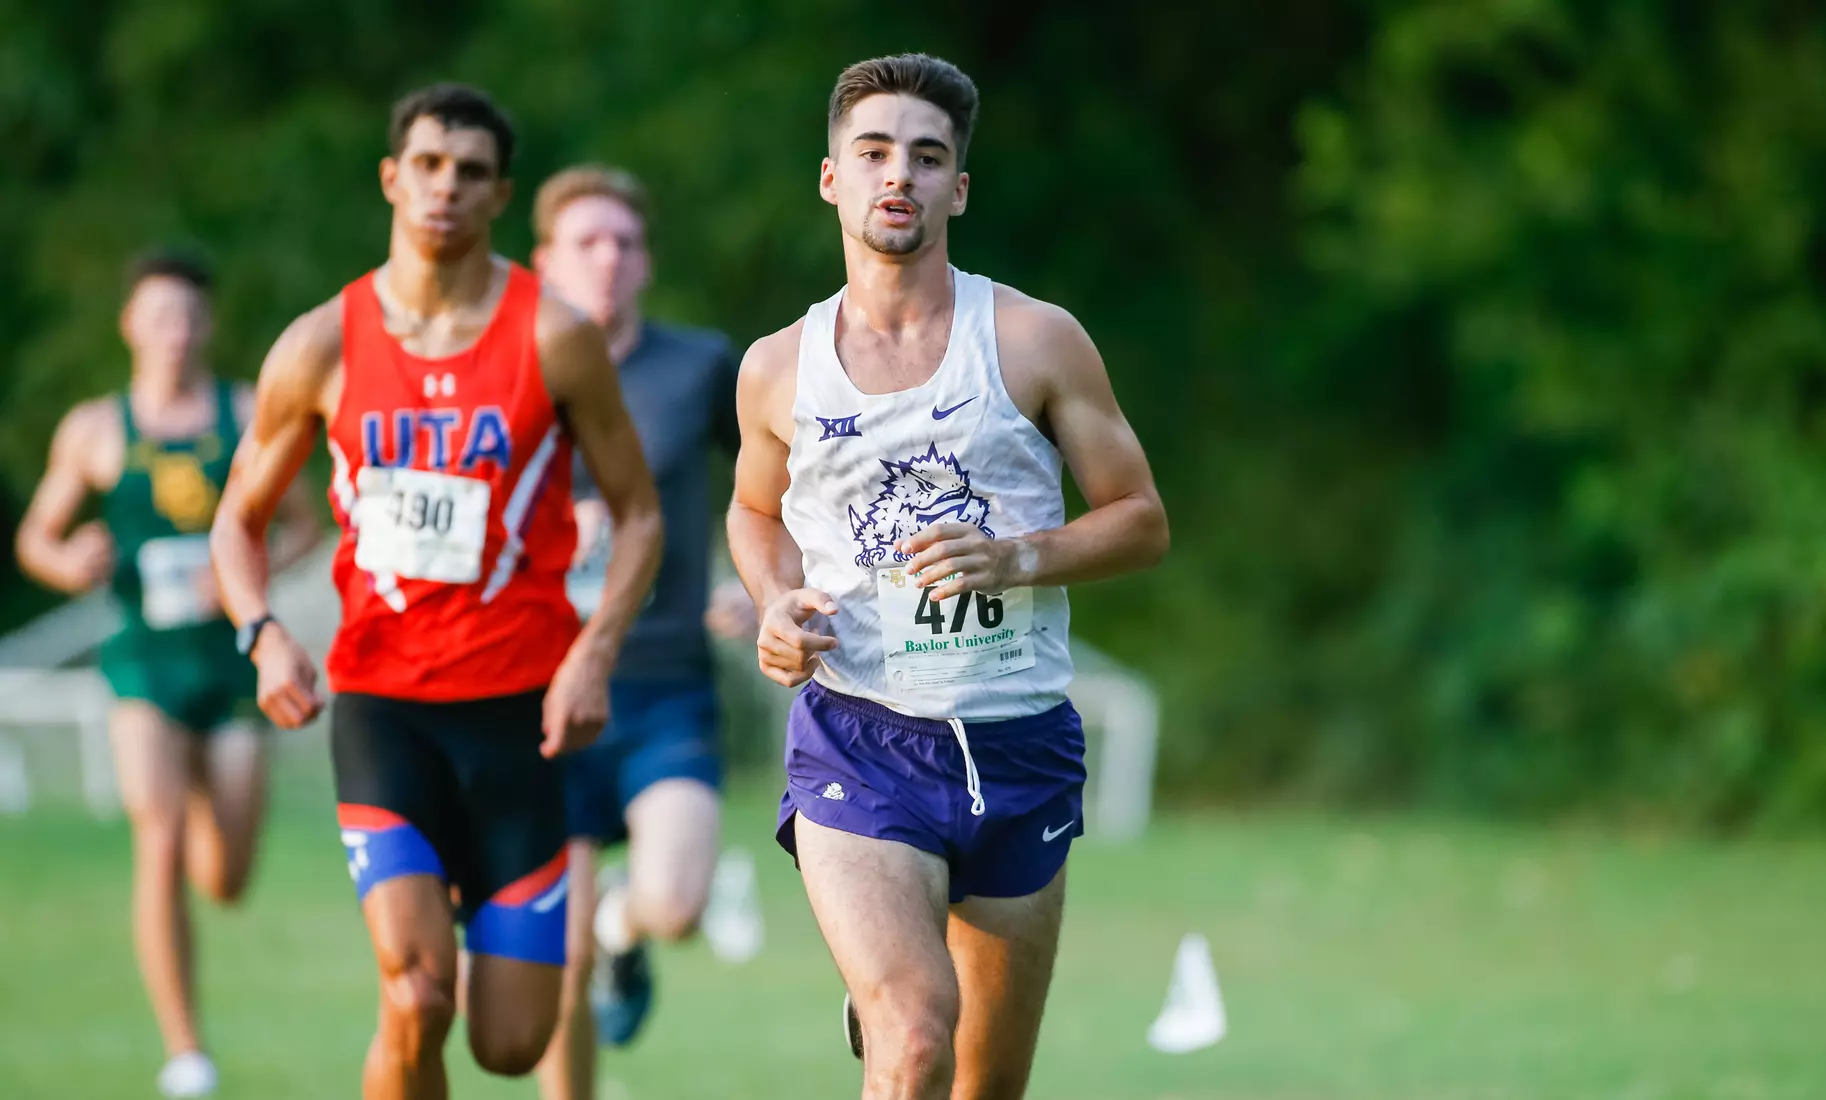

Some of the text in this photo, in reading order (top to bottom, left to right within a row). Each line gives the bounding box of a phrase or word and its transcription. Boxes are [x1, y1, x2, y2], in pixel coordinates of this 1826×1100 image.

[362, 406, 513, 469] UTA
[914, 585, 1004, 635] 476
[904, 628, 1016, 654] Baylor University
